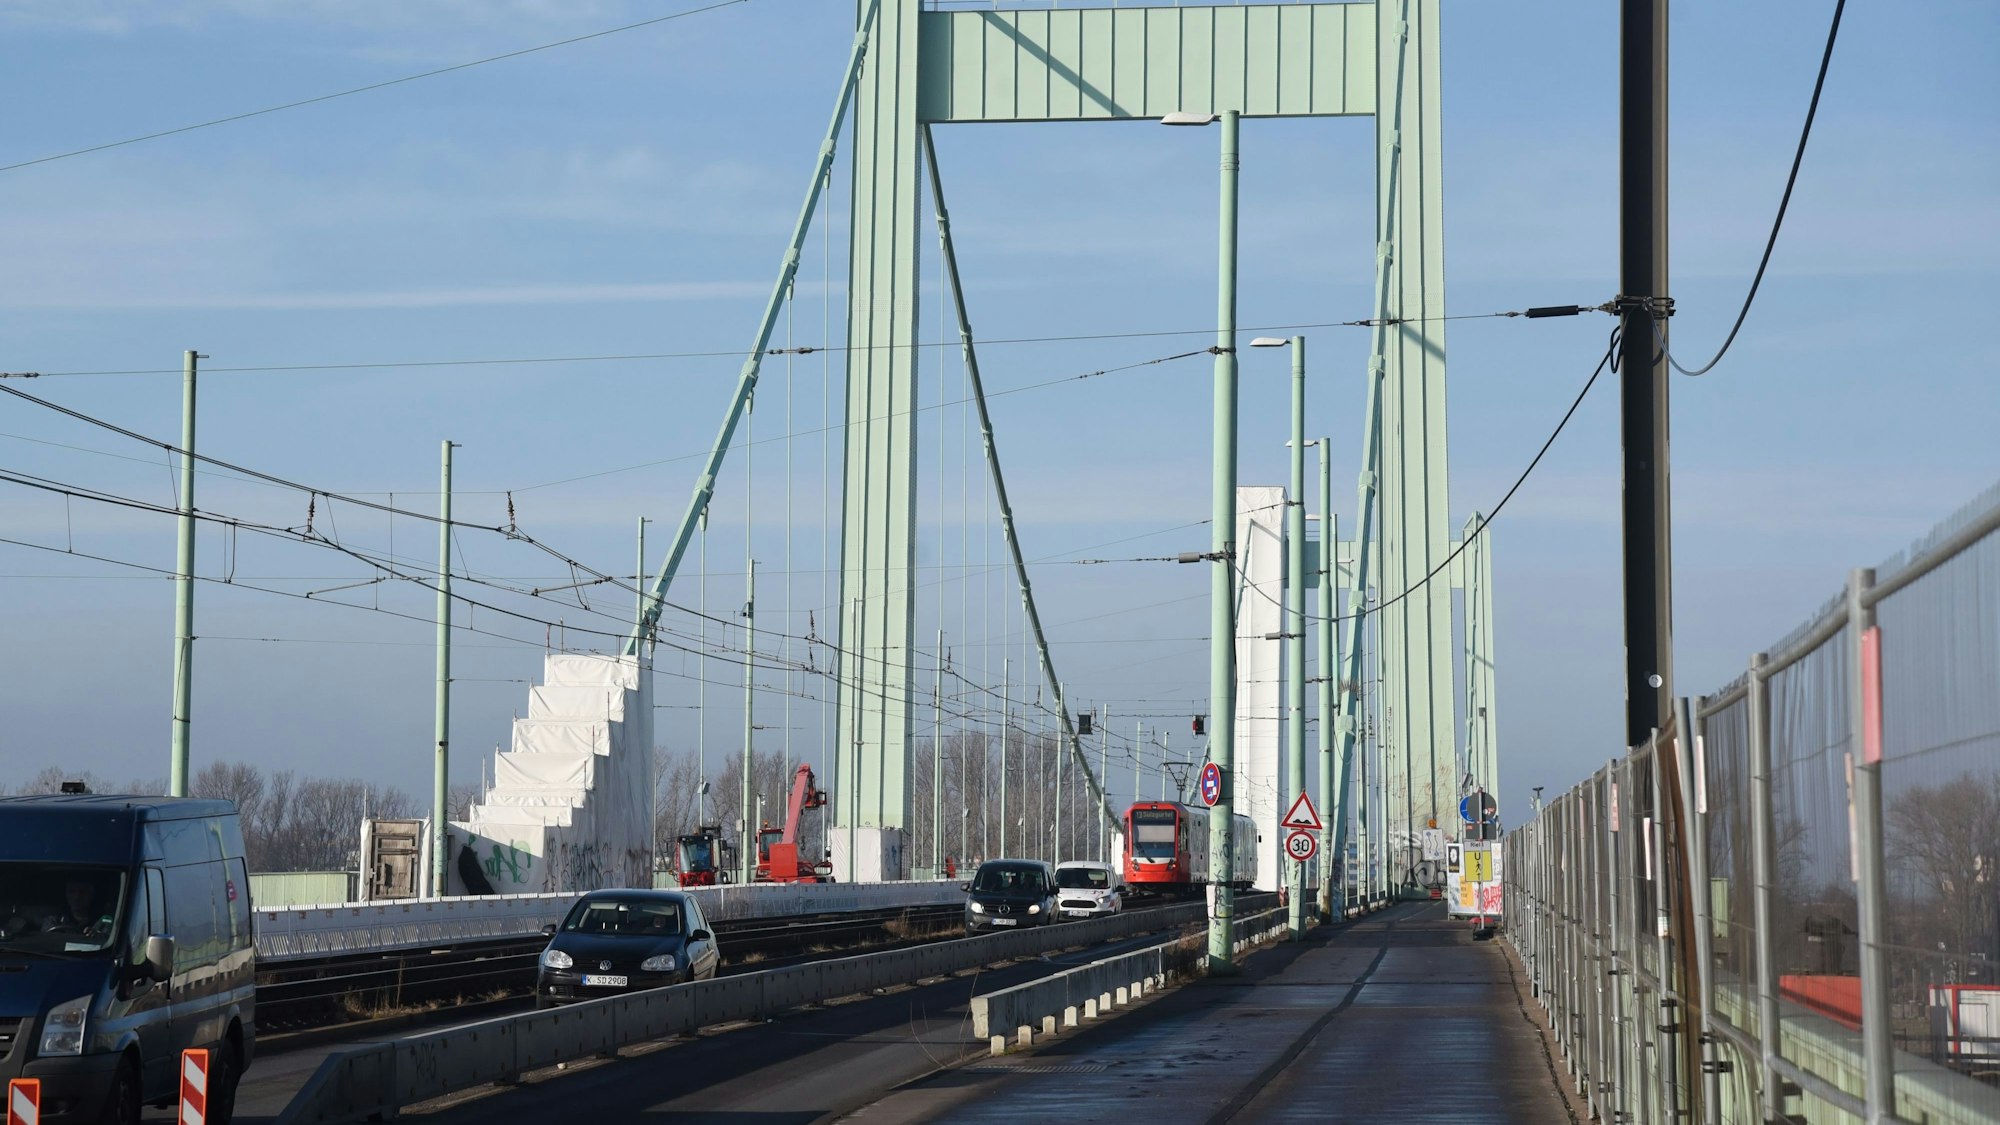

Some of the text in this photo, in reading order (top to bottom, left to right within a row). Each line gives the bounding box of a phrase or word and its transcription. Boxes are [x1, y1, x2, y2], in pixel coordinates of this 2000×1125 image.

[1292, 838, 1310, 852] 30
[1474, 852, 1480, 860] U
[608, 977, 626, 985] 2908
